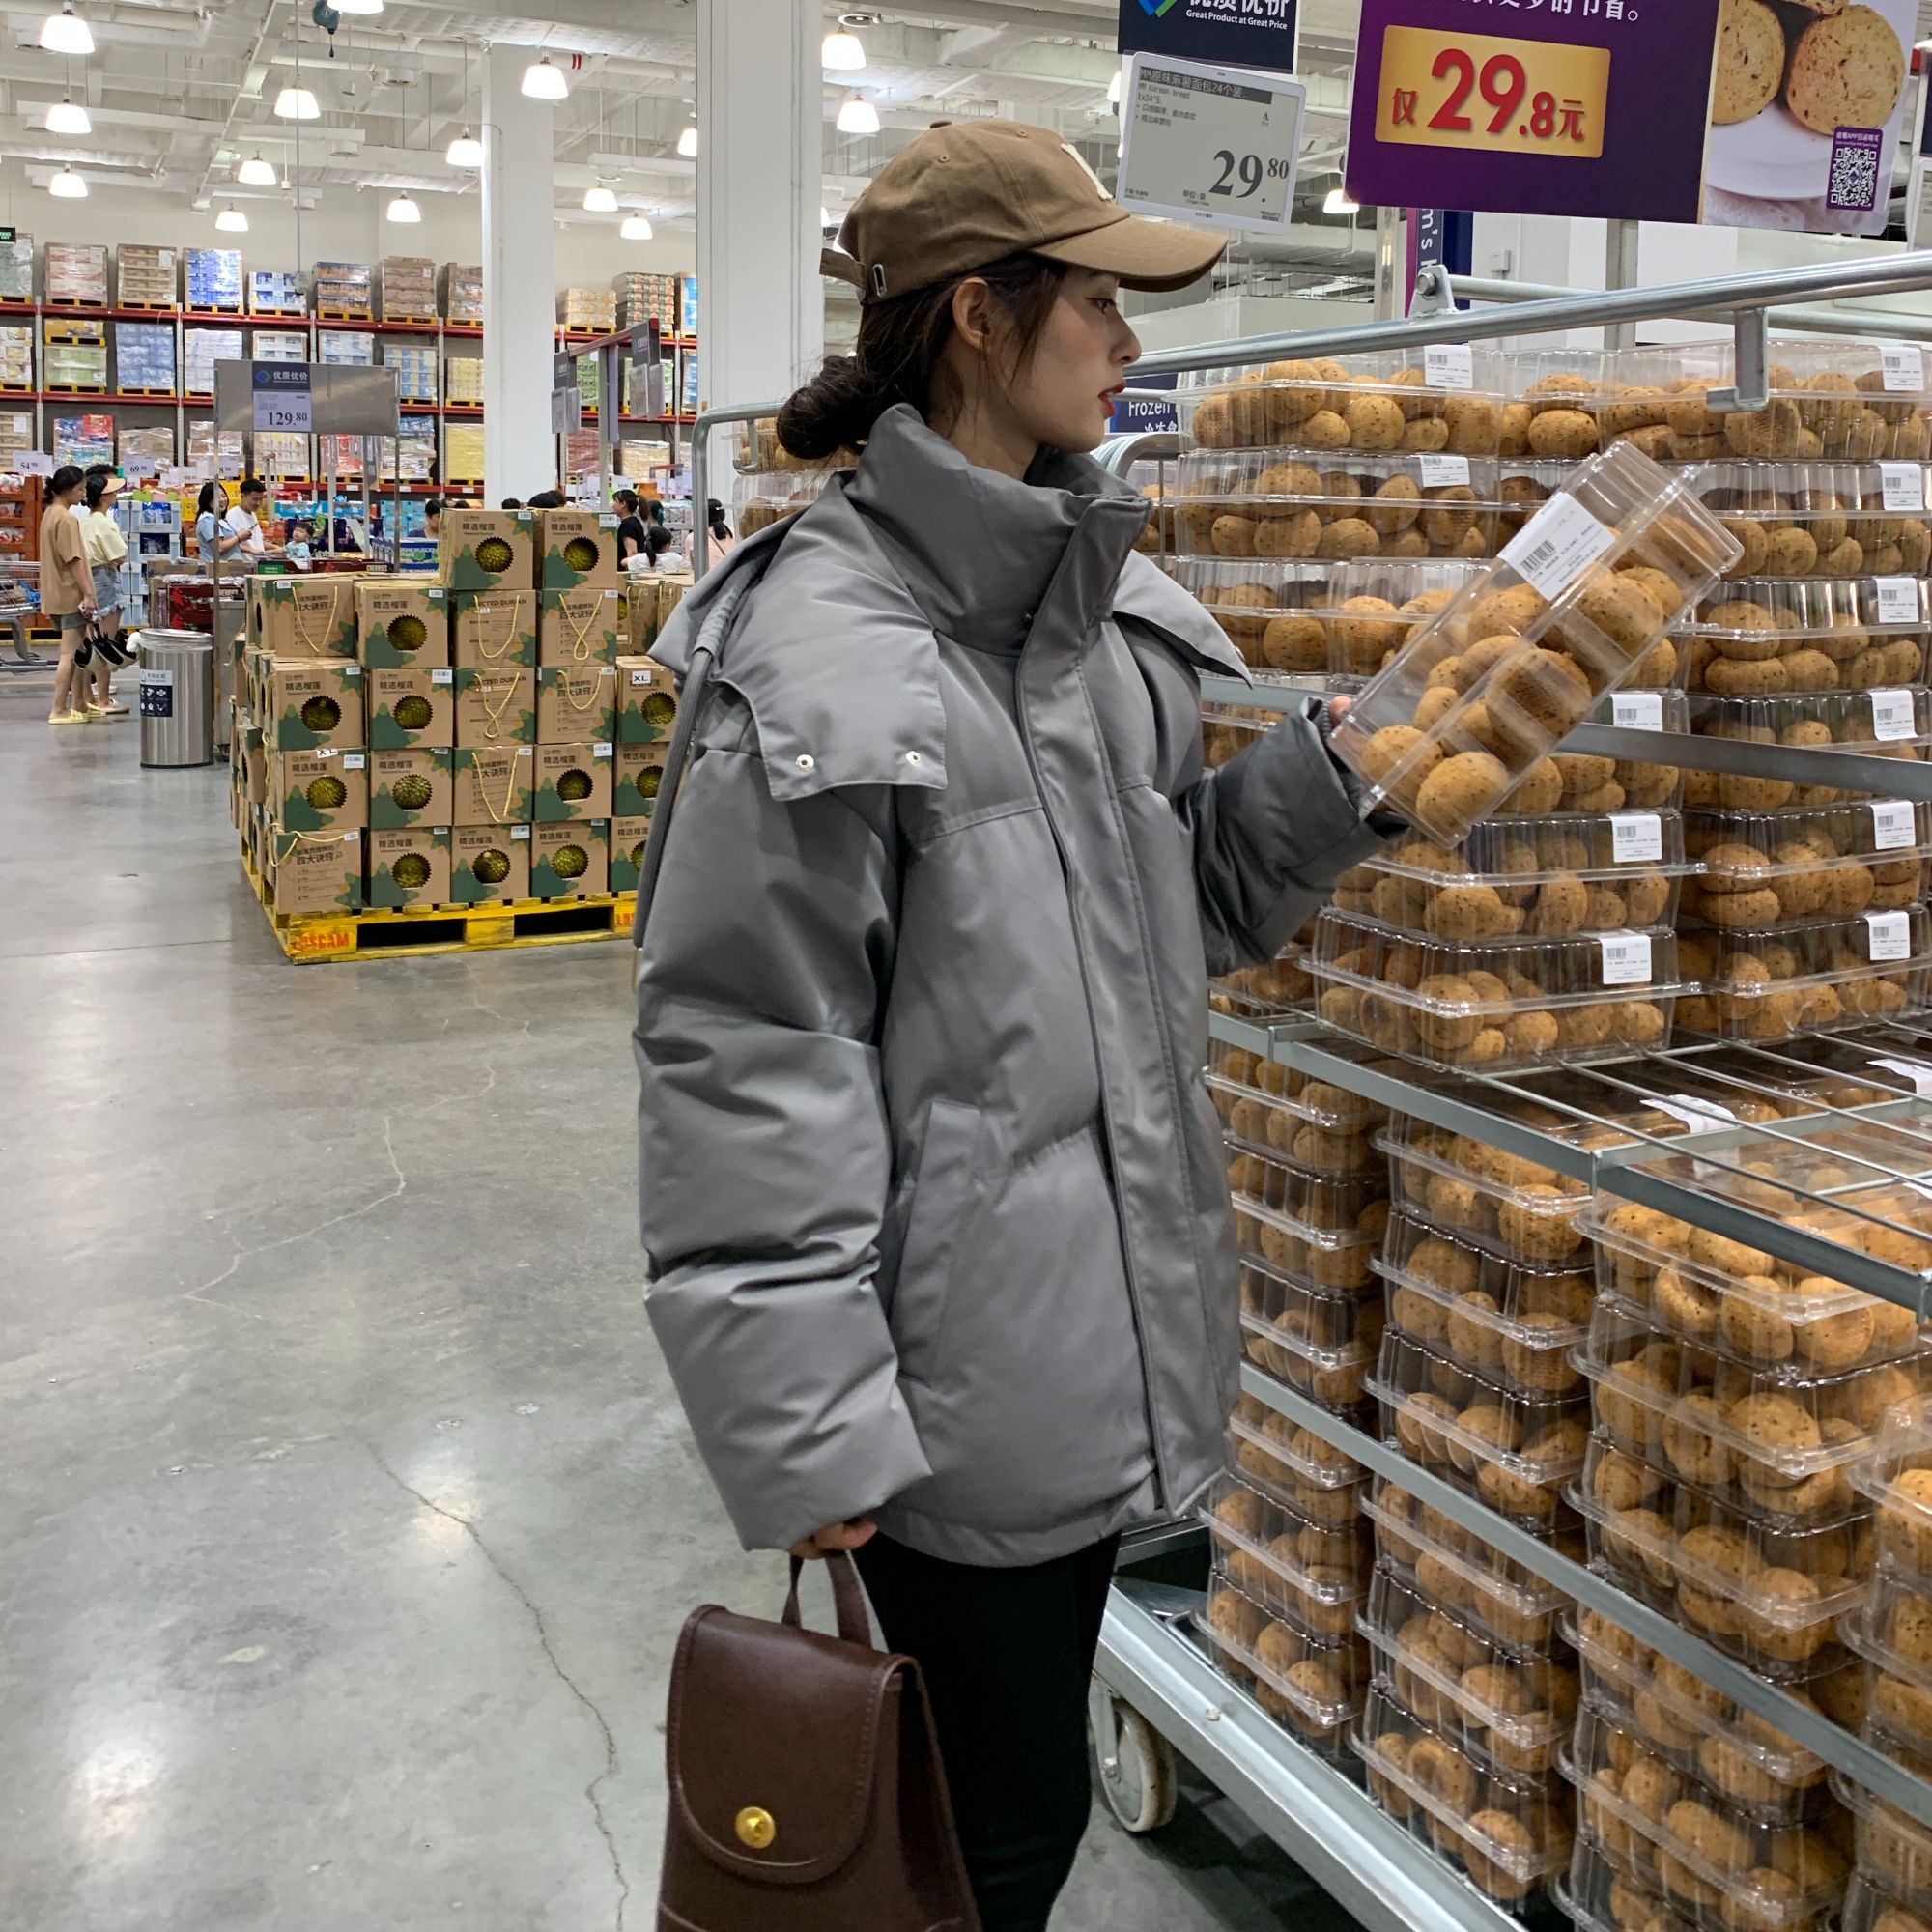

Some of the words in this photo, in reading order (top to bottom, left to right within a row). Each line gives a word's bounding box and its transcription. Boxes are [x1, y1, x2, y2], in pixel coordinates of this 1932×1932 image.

[1186, 9, 1208, 19] Great
[1208, 12, 1237, 24] Product
[1248, 17, 1268, 28] Great
[1269, 20, 1288, 30] Price
[273, 371, 308, 381] 优质优价
[1129, 401, 1171, 417] Frozen
